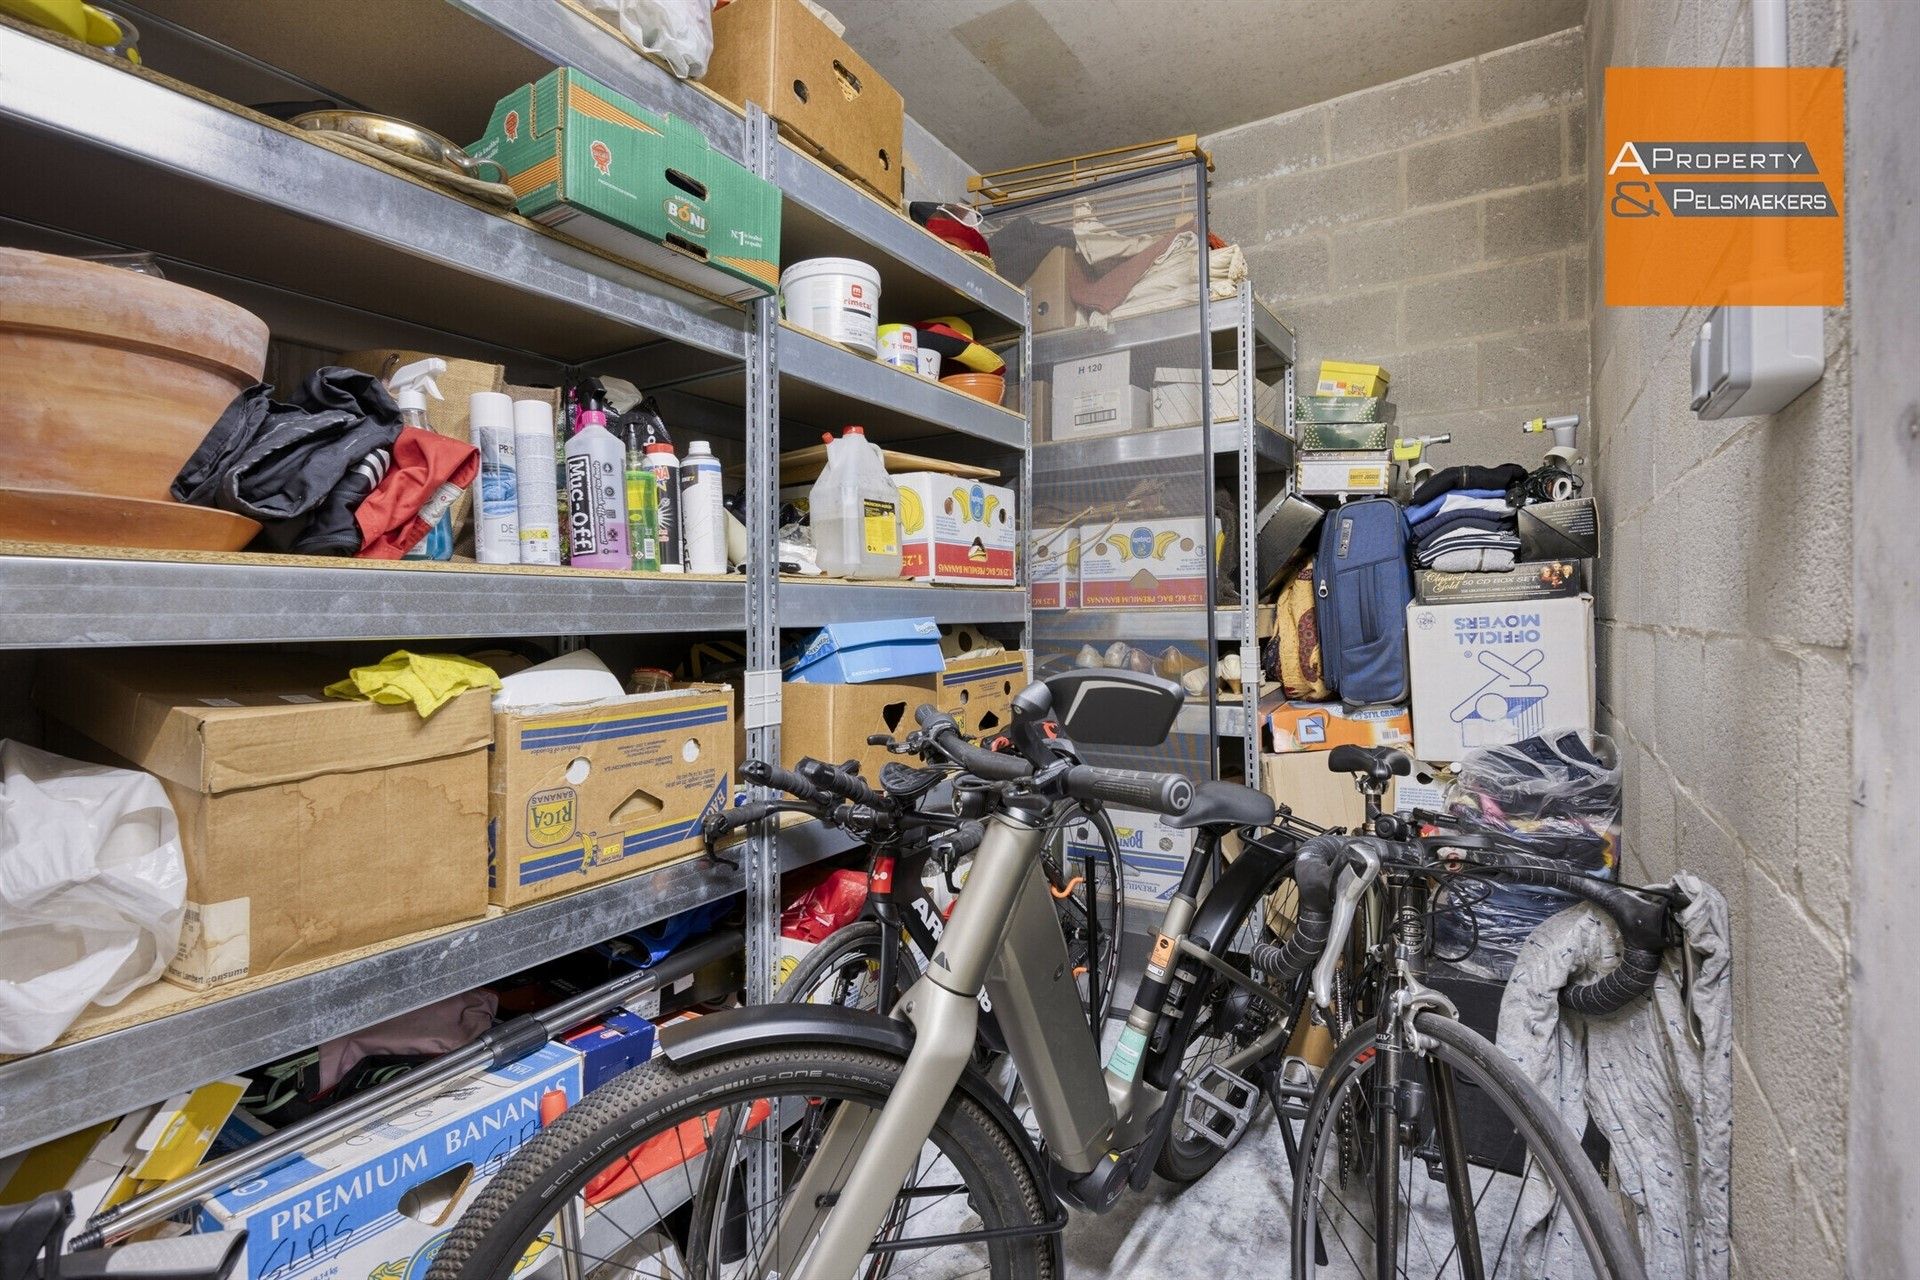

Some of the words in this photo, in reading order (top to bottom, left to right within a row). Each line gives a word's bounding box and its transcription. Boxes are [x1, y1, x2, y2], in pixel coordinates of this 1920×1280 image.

[1078, 366, 1085, 374] H
[1088, 363, 1102, 373] 120
[569, 461, 593, 549] Muc-Off
[1517, 575, 1538, 583] SET
[1087, 596, 1120, 604] BANANAS
[1454, 614, 1541, 630] MOVERS
[1454, 630, 1541, 645] OFFICIAL
[531, 790, 574, 805] BANANAS
[530, 800, 574, 828] RICA
[911, 897, 945, 942] AR
[752, 1069, 823, 1083] G-ONE
[541, 1109, 663, 1199] SCHWALBE
[271, 1143, 427, 1242] PREMIUM
